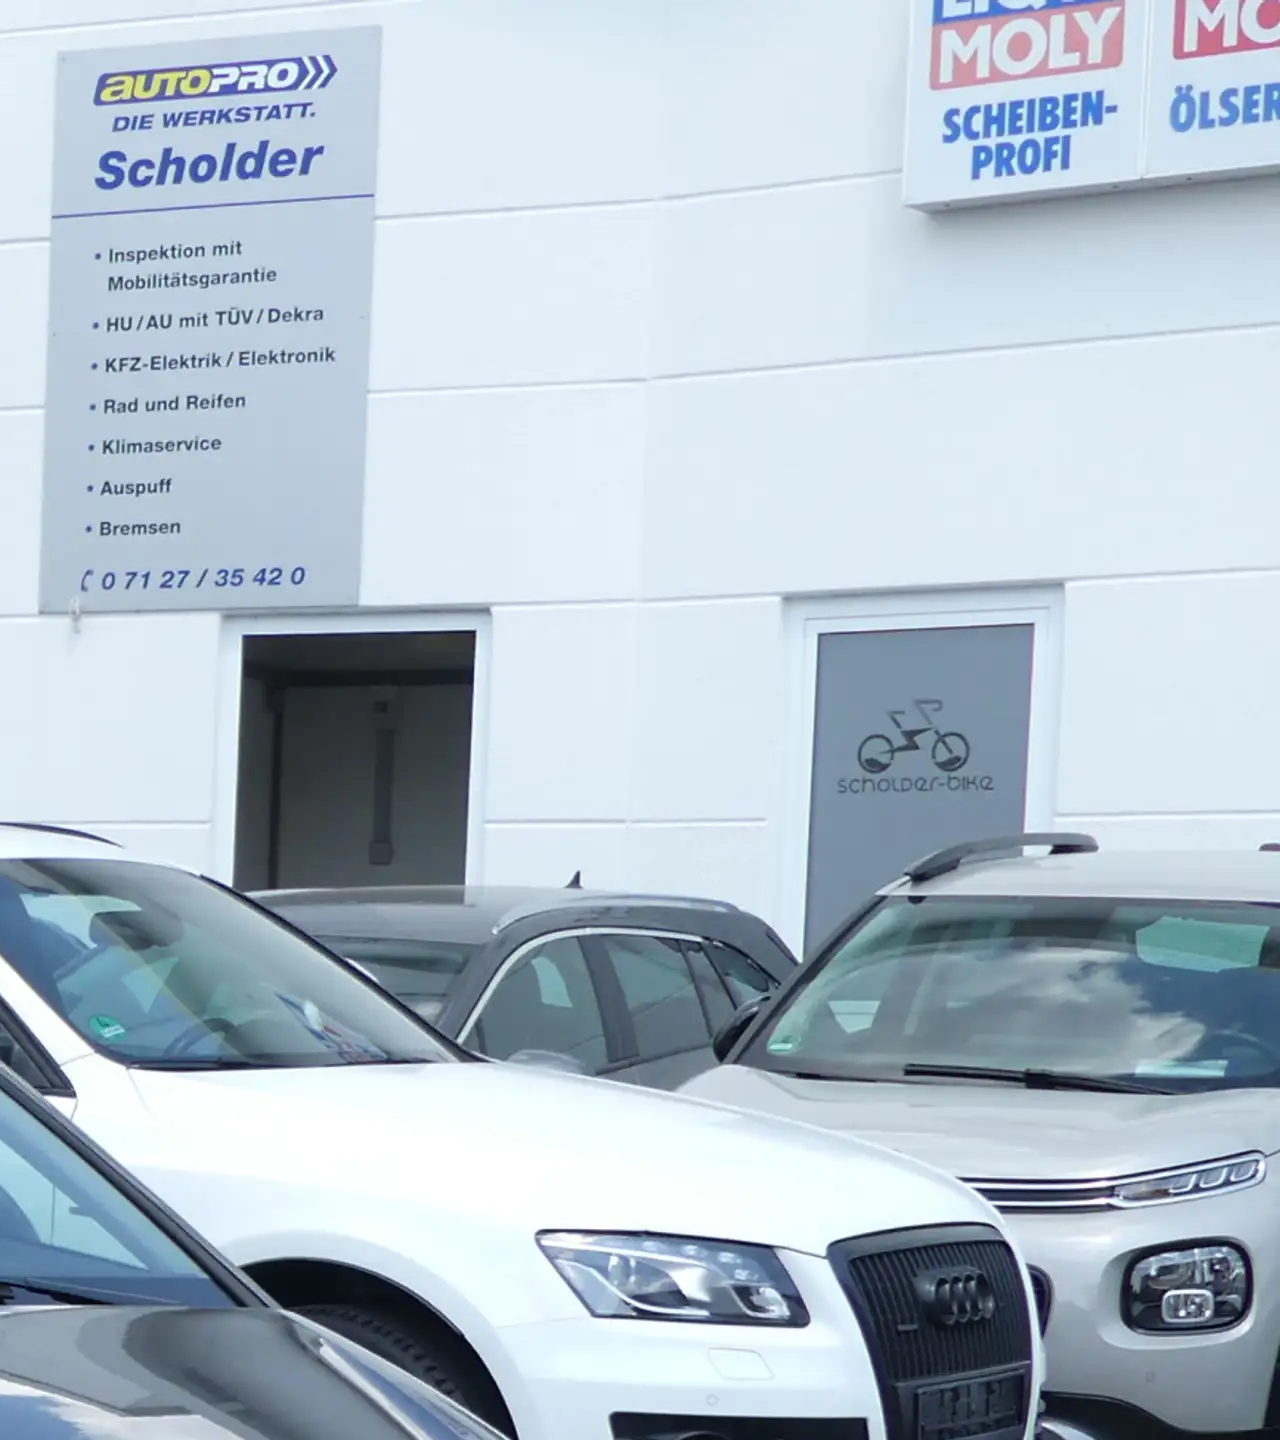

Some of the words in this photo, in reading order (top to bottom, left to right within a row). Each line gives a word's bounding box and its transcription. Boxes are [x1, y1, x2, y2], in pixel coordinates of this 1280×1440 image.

[940, 7, 1122, 83] MOLY
[112, 114, 155, 133] DIE
[163, 102, 315, 128] WERKSTATT.
[942, 90, 1117, 144] SCHEIBEN-
[95, 140, 324, 190] Scholder
[970, 134, 1071, 181] PROFI
[108, 244, 206, 266] Inspektion
[212, 240, 242, 257] mit
[109, 269, 276, 291] Mobilitätsgarantie
[179, 312, 209, 328] mit
[104, 352, 222, 373] KFZ-Elektrik
[238, 346, 336, 366] Elektronik
[104, 398, 138, 413] Rad
[146, 396, 179, 411] und
[187, 394, 245, 409] Reifen
[103, 439, 221, 454] Klimaservice
[101, 479, 171, 497] Auspuff
[100, 522, 180, 536] Bremsen
